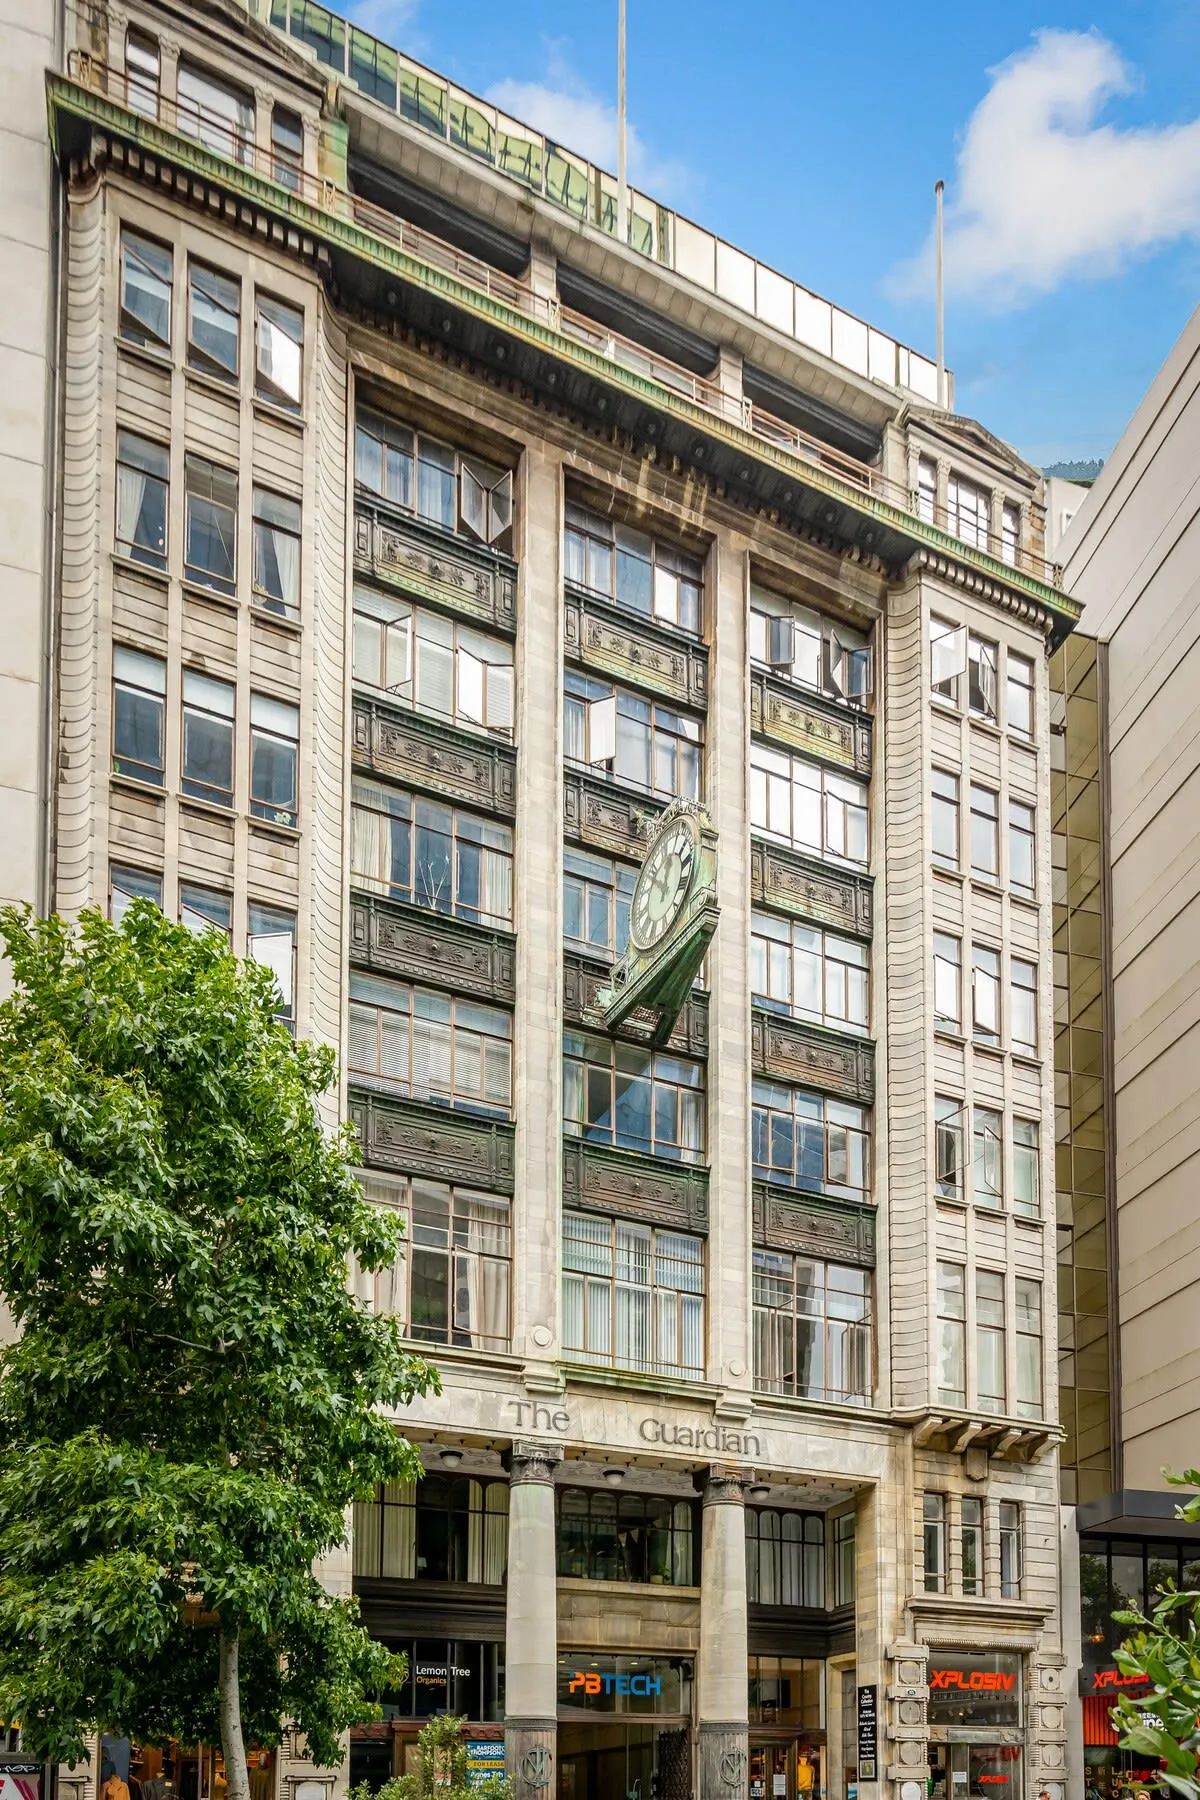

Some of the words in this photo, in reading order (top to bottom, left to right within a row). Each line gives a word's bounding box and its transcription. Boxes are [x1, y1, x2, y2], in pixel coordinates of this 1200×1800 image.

[507, 1400, 570, 1432] The
[639, 1418, 761, 1456] Guardian
[416, 1665, 447, 1676] Lemon
[451, 1666, 471, 1676] Tree
[416, 1676, 447, 1685] Organics
[929, 1670, 1016, 1690] XPLOSIV
